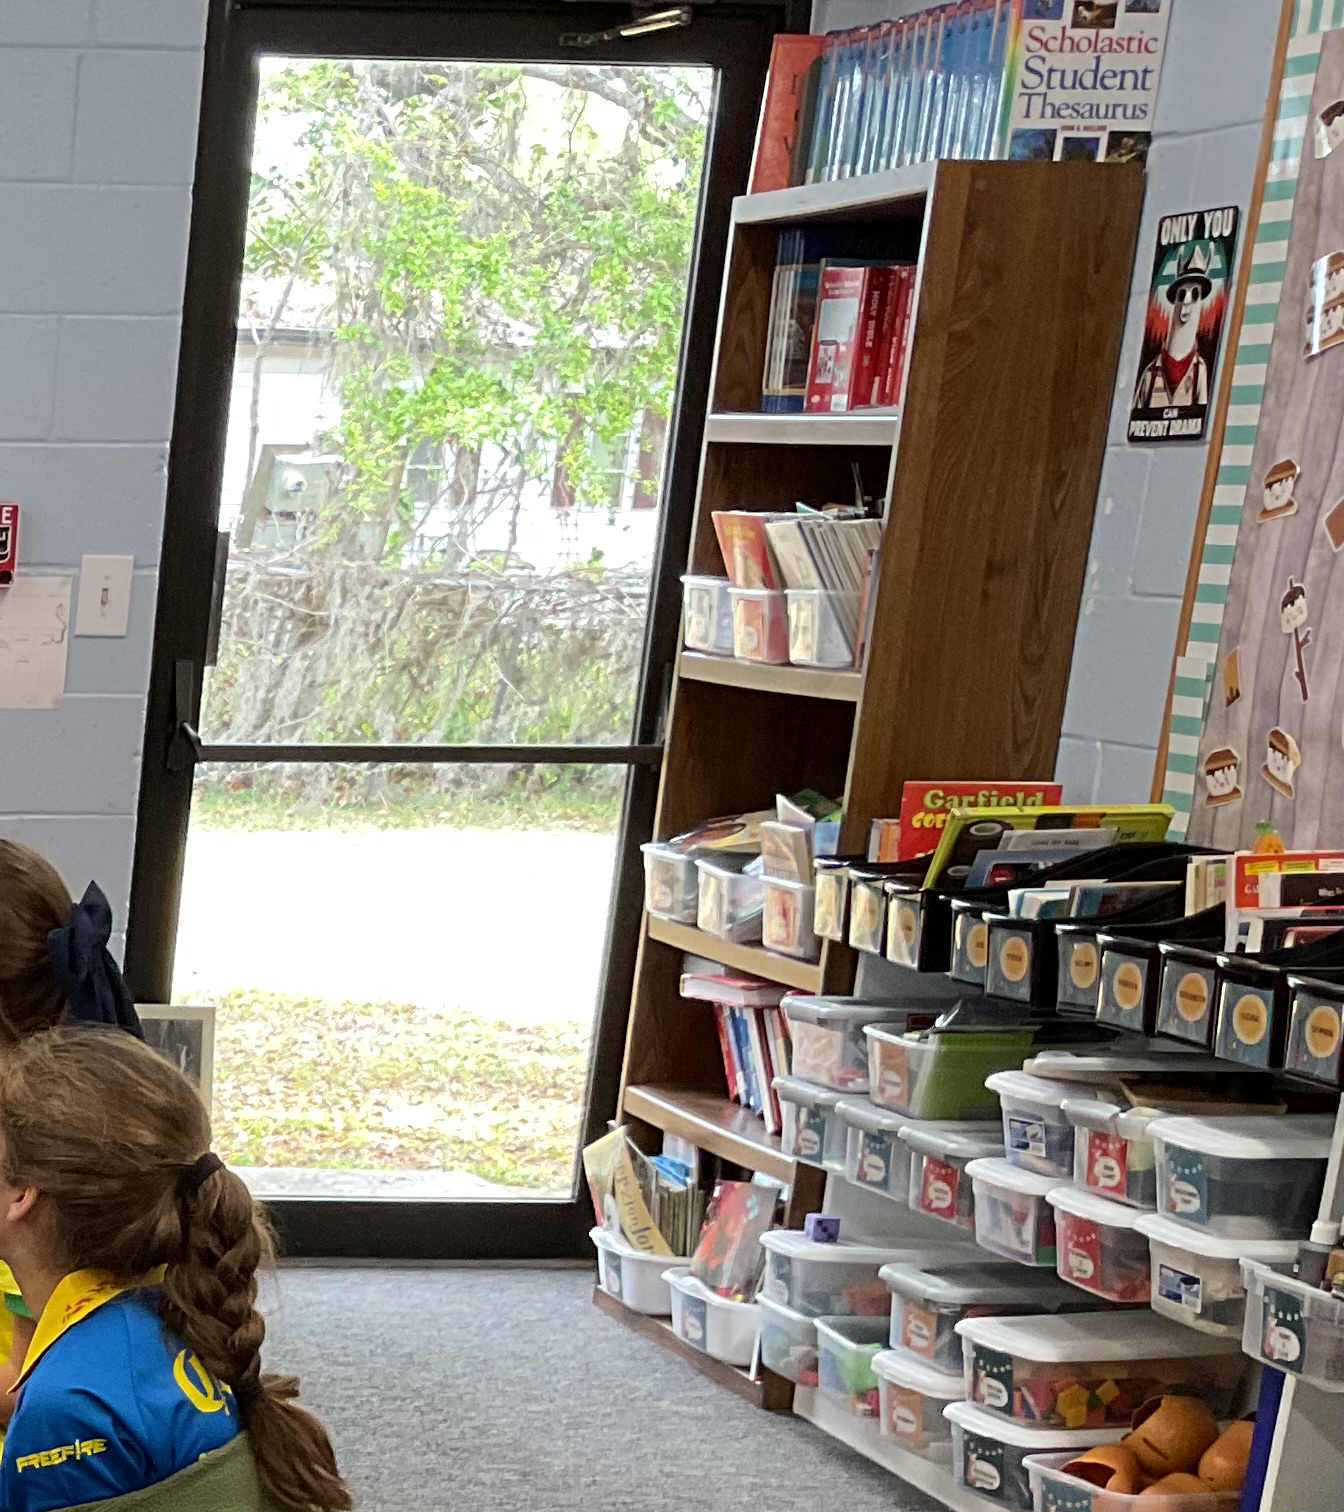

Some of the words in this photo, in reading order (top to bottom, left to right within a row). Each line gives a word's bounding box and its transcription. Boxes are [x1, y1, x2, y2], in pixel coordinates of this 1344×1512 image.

[1025, 26, 1159, 54] Scholastic
[1021, 55, 1154, 90] Student
[1018, 92, 1148, 120] Thesaurus
[1161, 214, 1198, 244] ONLY
[1204, 209, 1234, 238] YOU
[1163, 408, 1179, 418] CAN
[1128, 421, 1169, 437] PREVENT
[1170, 418, 1203, 436] DRAMA
[924, 790, 1044, 811] Garfield
